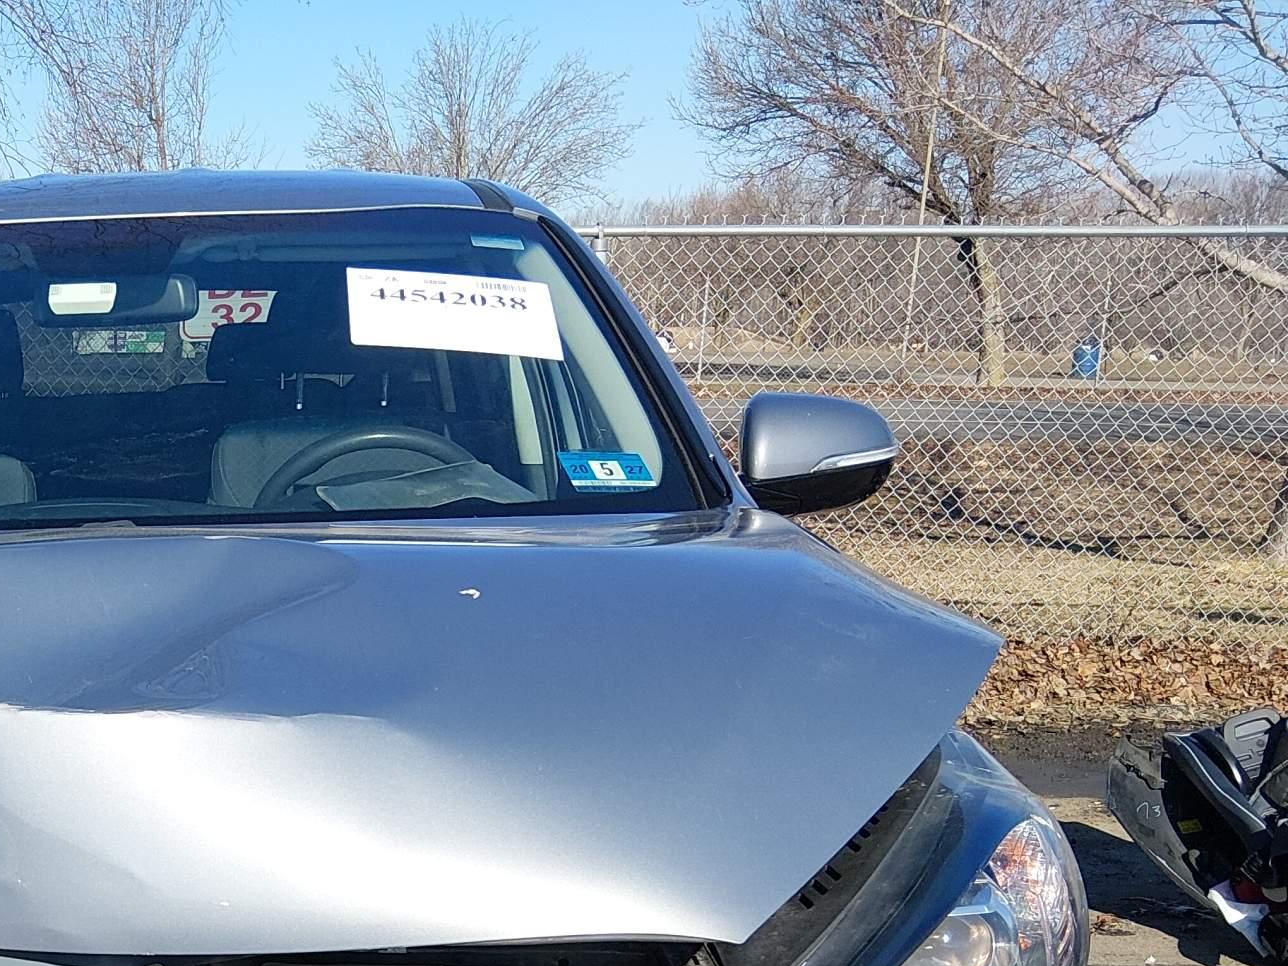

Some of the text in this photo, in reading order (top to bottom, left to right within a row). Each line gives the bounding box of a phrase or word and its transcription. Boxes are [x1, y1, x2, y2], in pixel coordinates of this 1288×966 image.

[370, 287, 528, 311] 44542038
[212, 302, 263, 325] 32
[570, 462, 643, 476] 20 5 27
